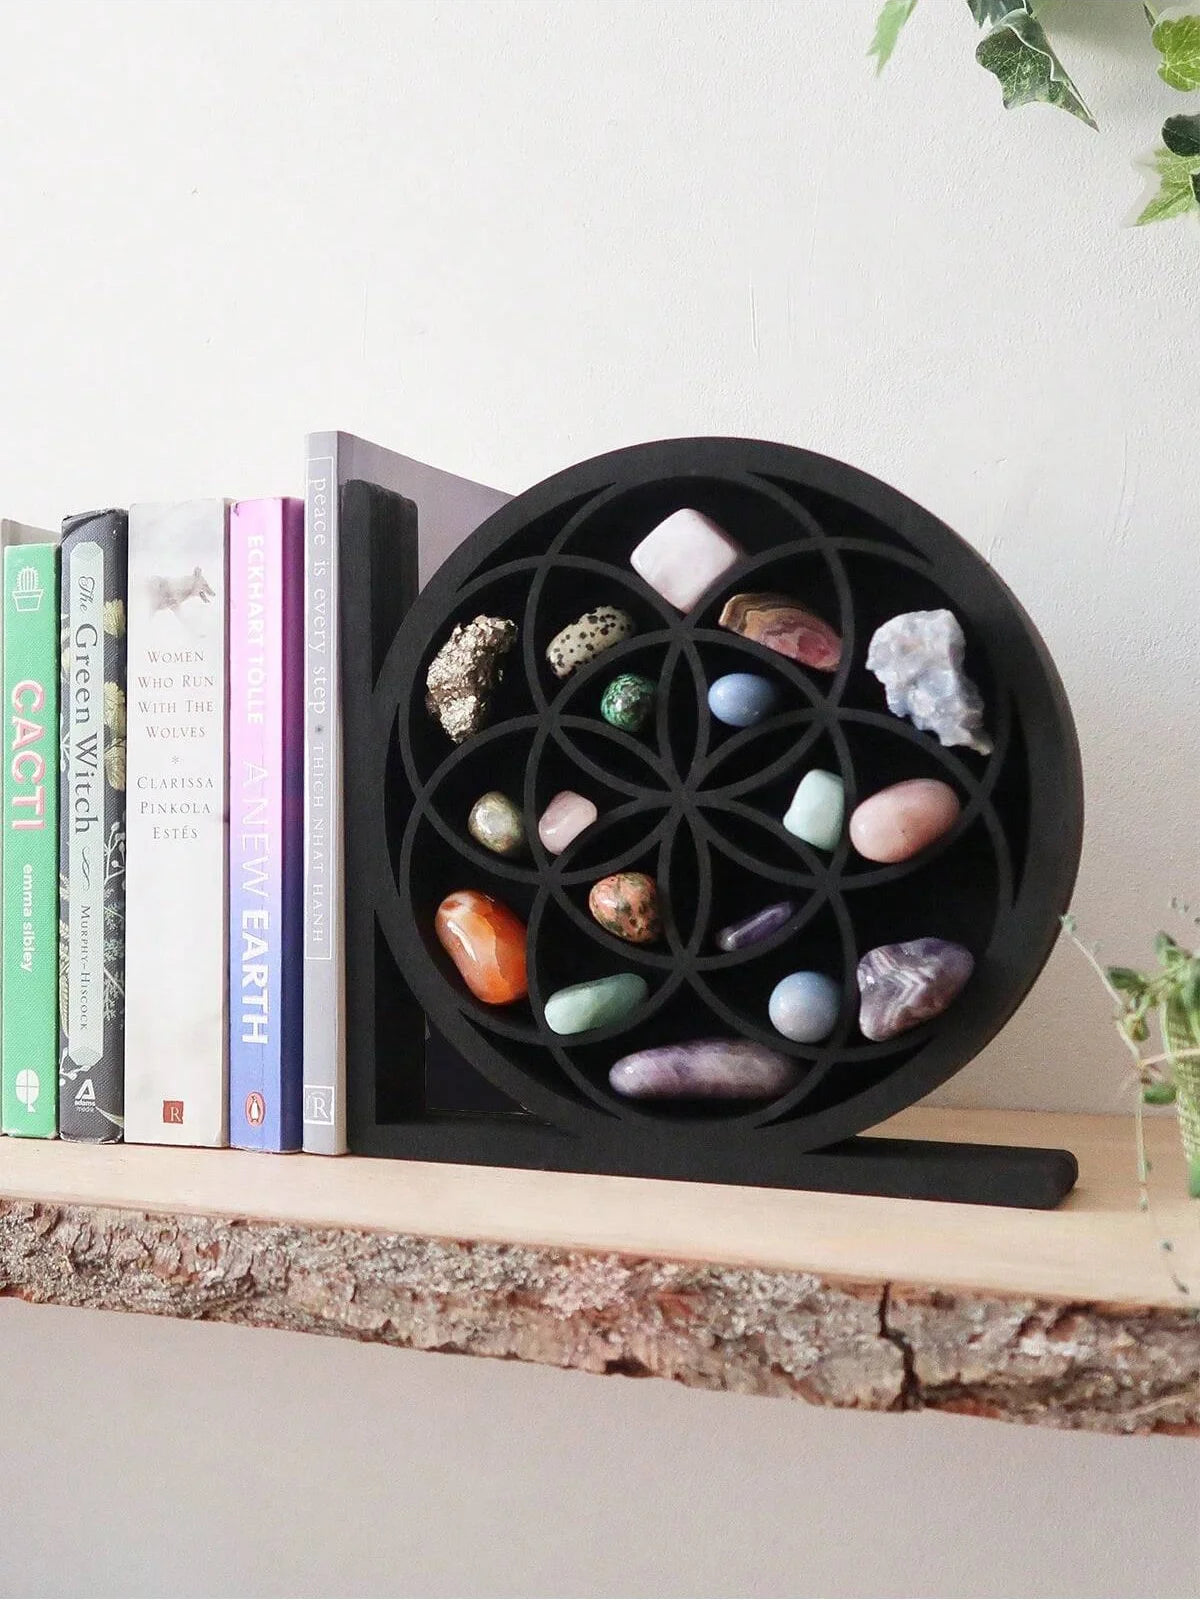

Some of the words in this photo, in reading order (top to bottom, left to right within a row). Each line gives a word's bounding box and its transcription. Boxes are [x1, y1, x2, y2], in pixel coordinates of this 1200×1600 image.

[309, 477, 327, 546] peace
[79, 576, 97, 613] The
[247, 535, 264, 645] ECKHART
[314, 561, 329, 576] is
[308, 590, 327, 654] every
[75, 623, 98, 724] Green
[138, 676, 173, 689] WHO
[183, 675, 214, 688] RUN
[147, 651, 204, 664] WOMEN
[138, 701, 176, 714] WITH
[186, 700, 214, 713] THE
[247, 650, 263, 725] TOLLE
[308, 666, 328, 714] step
[12, 680, 46, 829] CACTI
[146, 726, 206, 739] WOLVES
[75, 732, 98, 833] Witch
[137, 776, 214, 789] CLARISSA
[244, 762, 269, 787] A
[313, 744, 324, 806] THICH
[140, 801, 211, 814] PINKOLA
[242, 798, 270, 901] NEW
[312, 818, 323, 873] NHAT
[23, 864, 33, 917] emma
[312, 886, 323, 942] HANH
[20, 920, 36, 973] sibley
[243, 909, 269, 1044] EARTH
[170, 1106, 182, 1122] R
[313, 1096, 329, 1119] R
